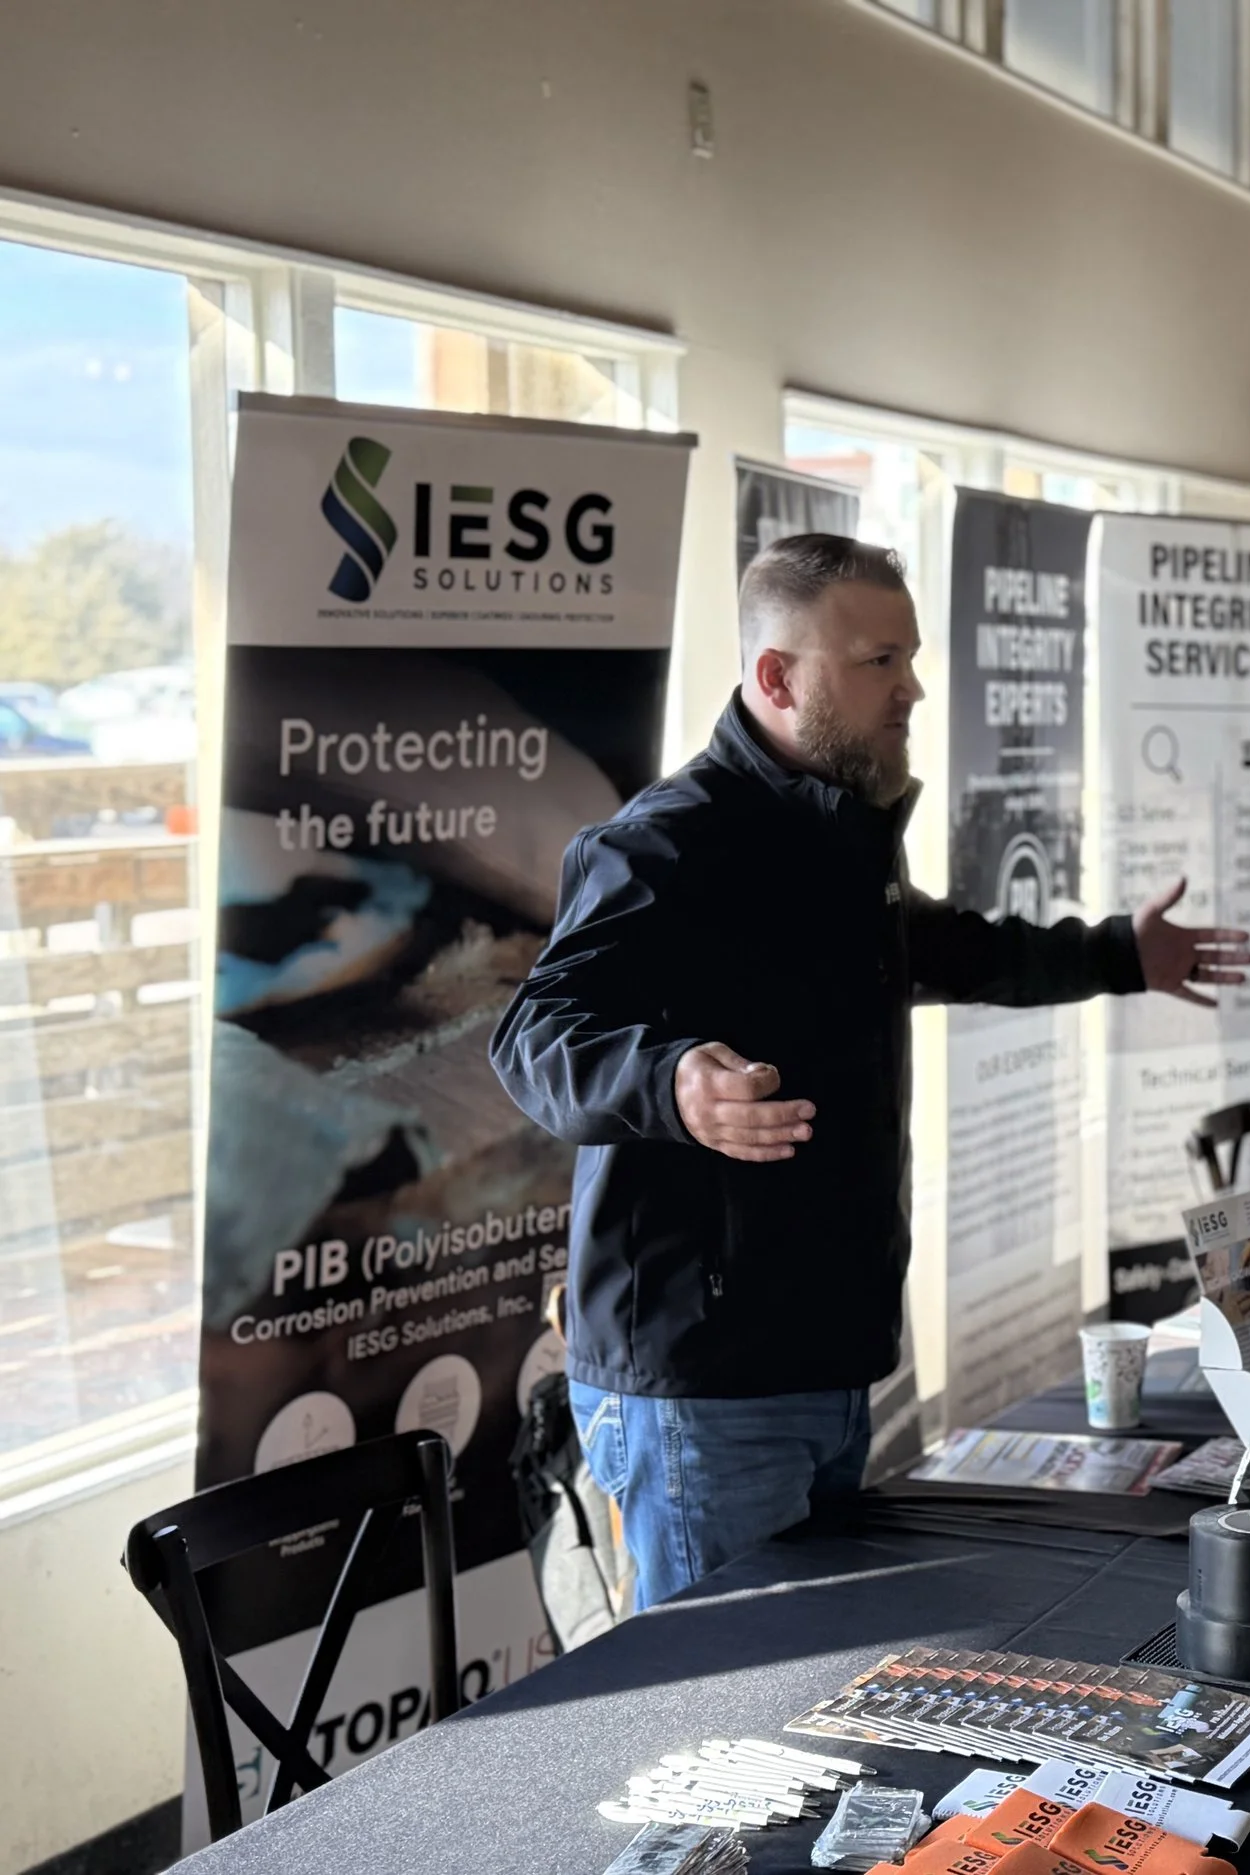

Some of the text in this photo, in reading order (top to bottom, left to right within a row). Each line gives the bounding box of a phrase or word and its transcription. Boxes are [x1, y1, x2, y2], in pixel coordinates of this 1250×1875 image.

[413, 481, 616, 566] IESG
[413, 567, 614, 595] SOLUTIONS
[983, 565, 1070, 619] PIPELINE
[975, 622, 1077, 673] INTEGRITY
[984, 680, 1068, 727] EXPERTS
[279, 714, 549, 781] Protecting
[275, 799, 497, 852] the future
[1197, 1210, 1229, 1236] IESG
[272, 1238, 349, 1297] PIB
[230, 1297, 364, 1345] Corrosion
[370, 1266, 489, 1316] Prevention
[493, 1246, 535, 1283] and
[346, 1294, 534, 1361] IESG Solutions, Inc.
[314, 1656, 498, 1770] TOPQ
[1155, 1708, 1194, 1733] IESG
[984, 1774, 1027, 1800] IESG
[1054, 1768, 1097, 1801] IESG
[1124, 1780, 1158, 1815] IESG
[1012, 1801, 1062, 1839] IESG
[1034, 1809, 1071, 1842] SOLUTIONS
[1103, 1819, 1147, 1854] IESG
[1126, 1827, 1157, 1857] SOLUTIONS
[946, 1850, 998, 1875] IESG
